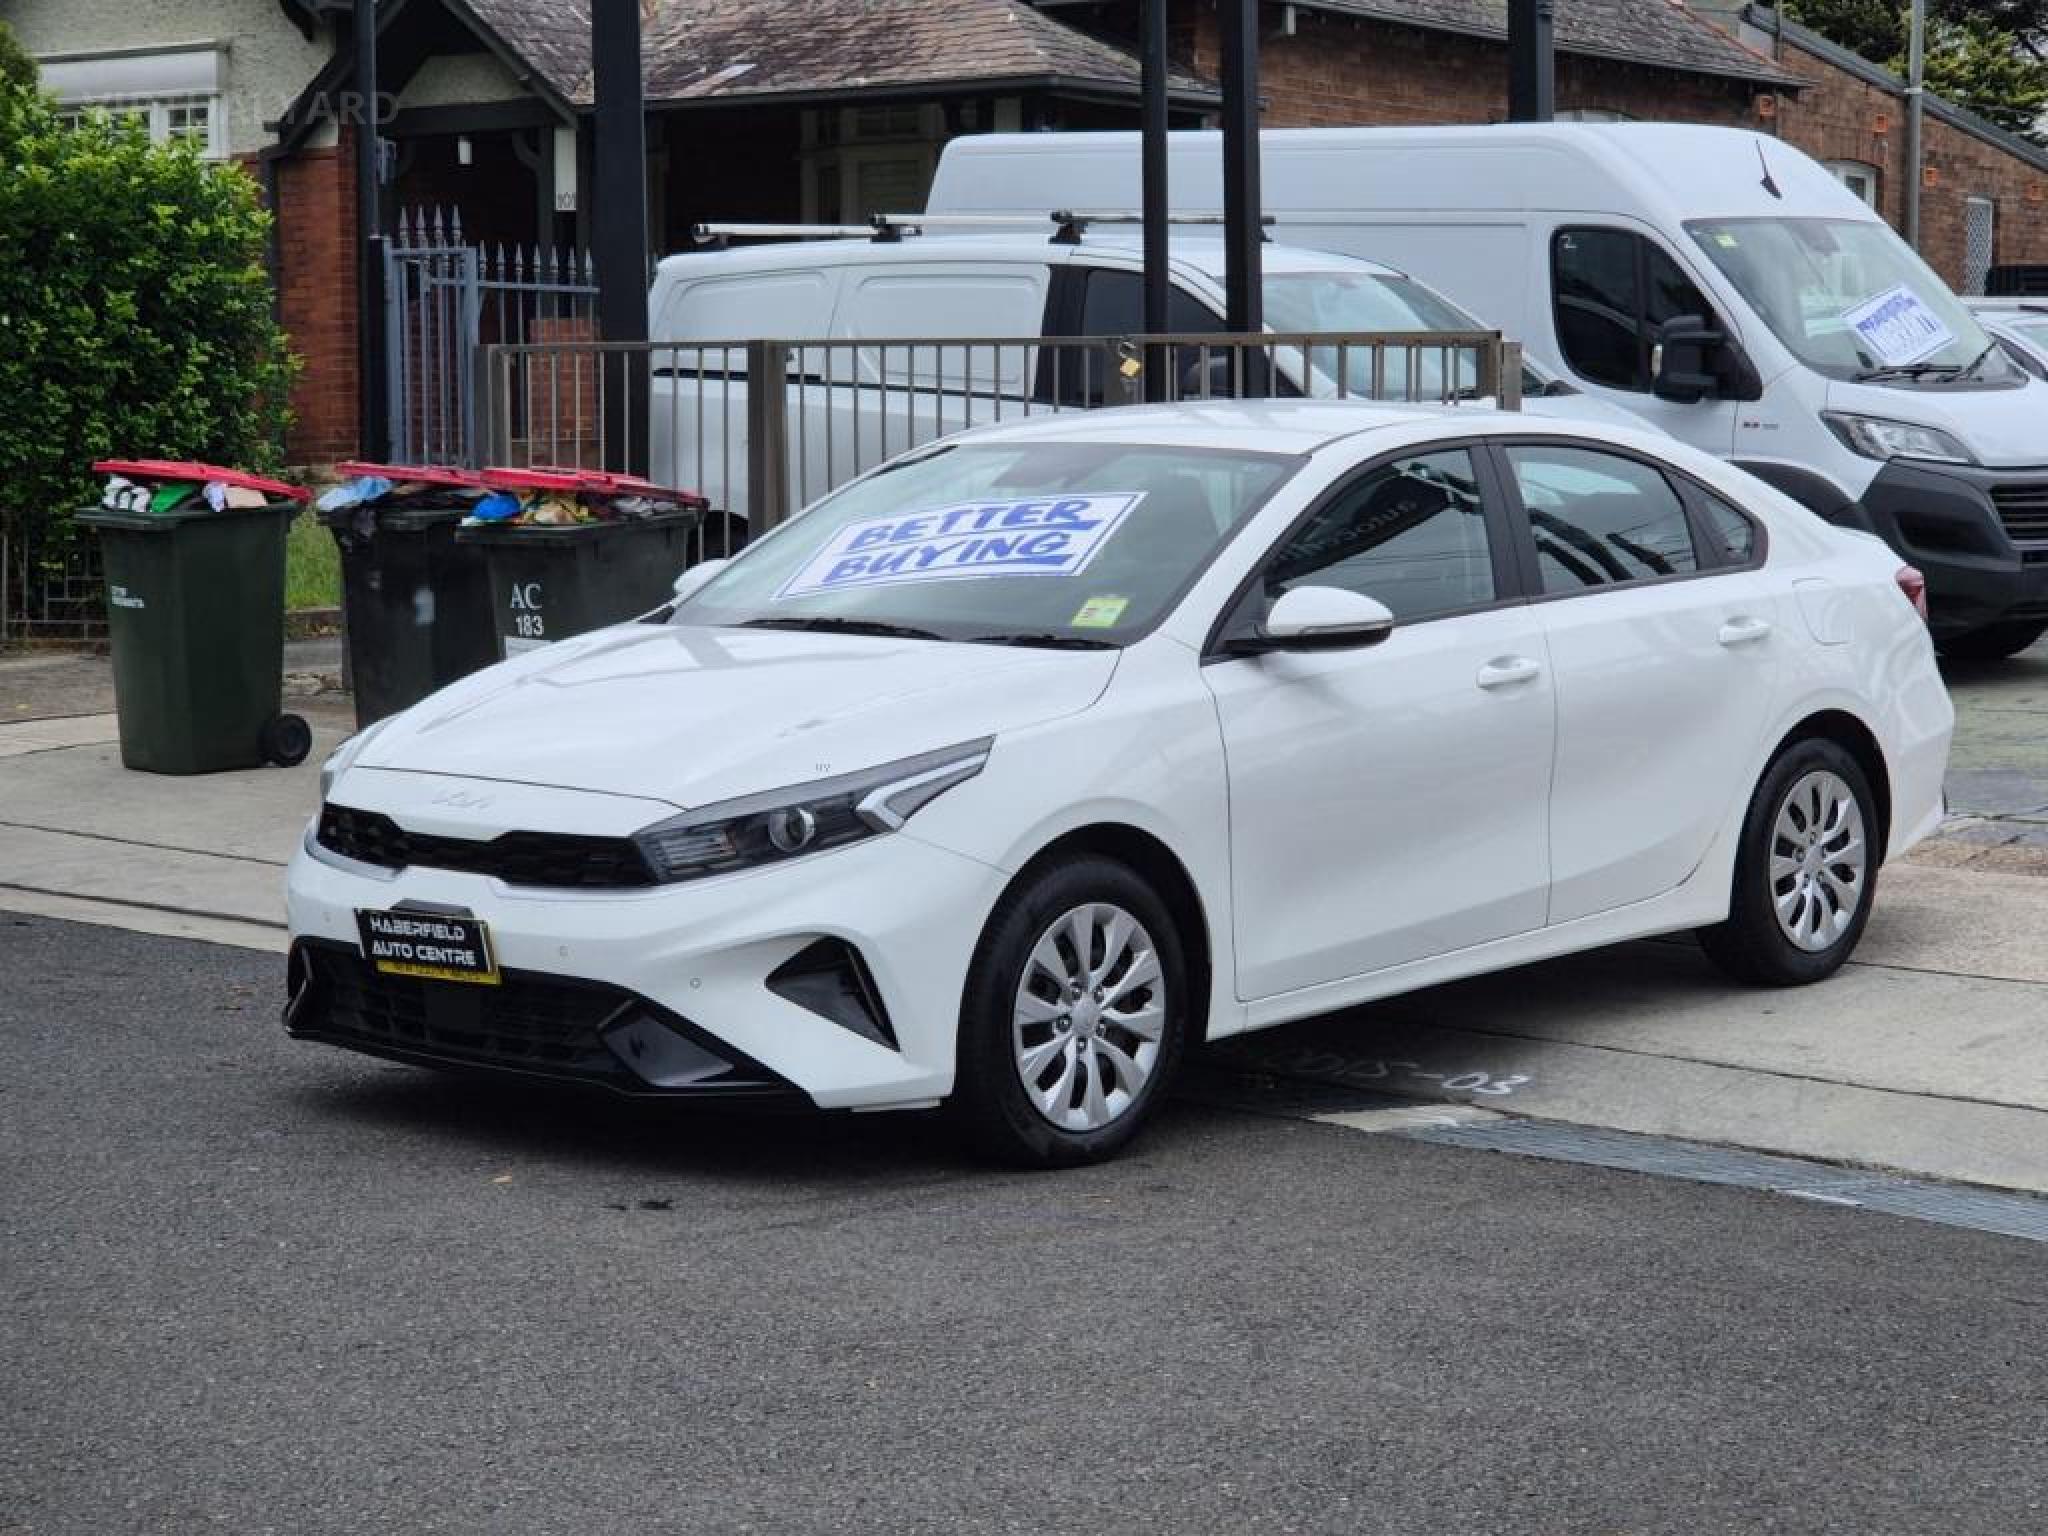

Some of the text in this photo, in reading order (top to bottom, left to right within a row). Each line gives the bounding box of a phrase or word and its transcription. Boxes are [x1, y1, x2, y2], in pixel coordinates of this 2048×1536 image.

[849, 499, 1092, 549] BETTER
[822, 532, 1072, 584] BUYING
[510, 583, 543, 609] AC
[516, 614, 544, 636] 183
[370, 917, 465, 940] HABERFIELD
[372, 940, 477, 965] AUTO CENTRE
